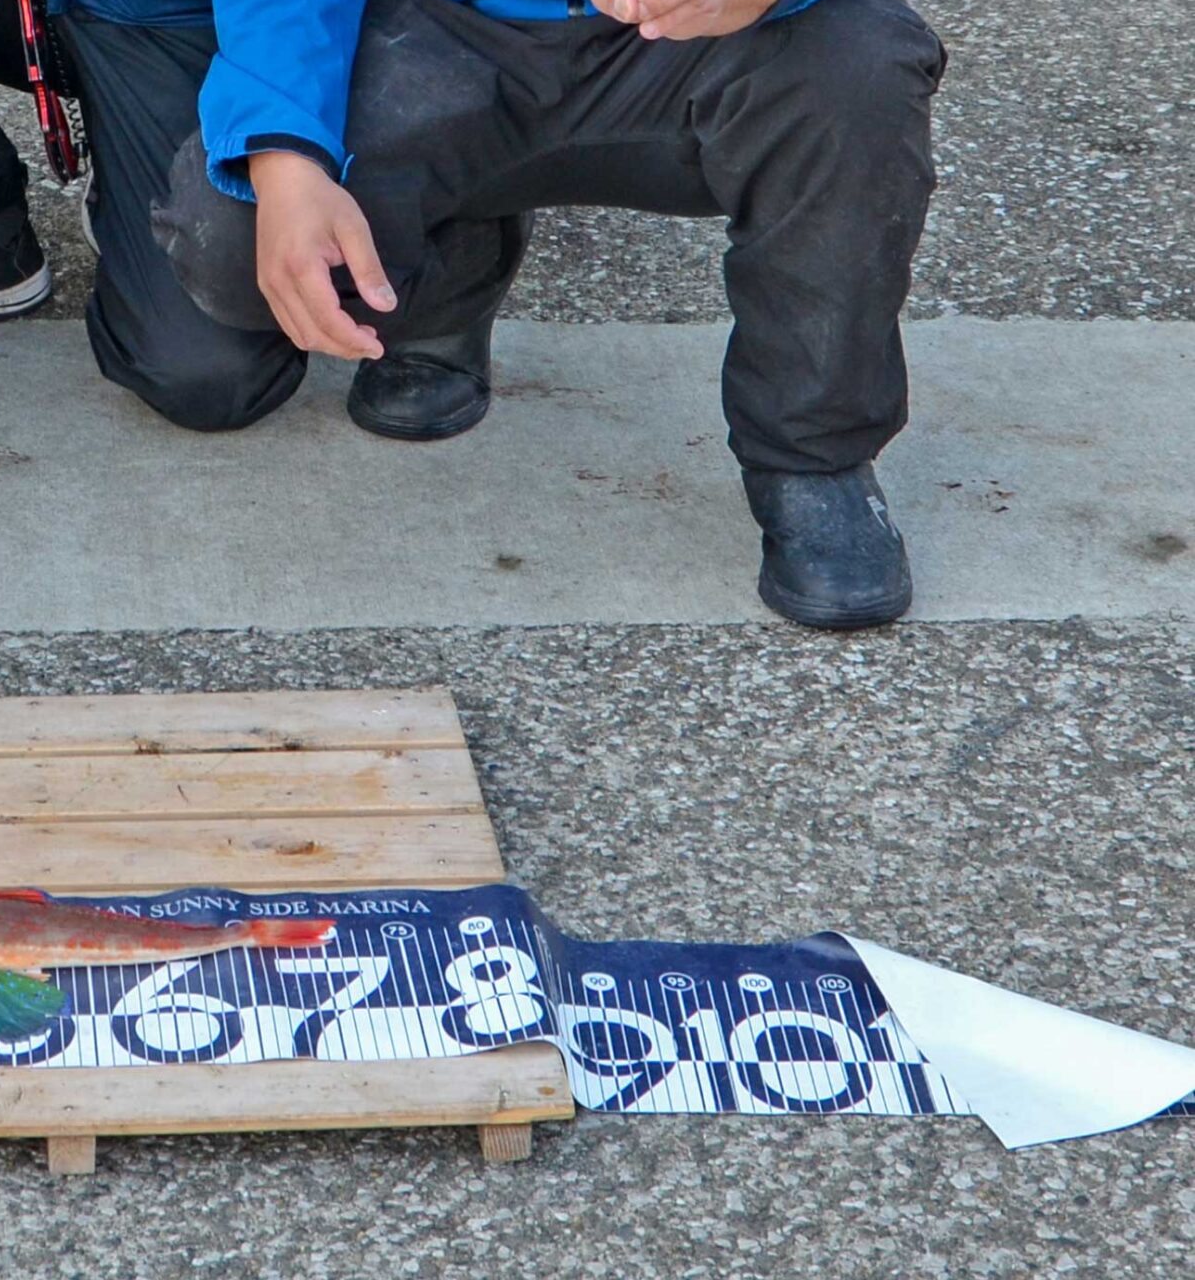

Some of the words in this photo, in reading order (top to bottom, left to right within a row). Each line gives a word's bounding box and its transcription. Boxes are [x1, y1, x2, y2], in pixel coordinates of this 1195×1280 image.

[149, 895, 242, 919] SUNNY
[249, 900, 310, 917] SIDE
[316, 899, 432, 916] MARINA
[111, 959, 244, 1063] 6
[274, 956, 390, 1058] 7
[441, 945, 555, 1048] 8
[559, 1003, 679, 1112] 9
